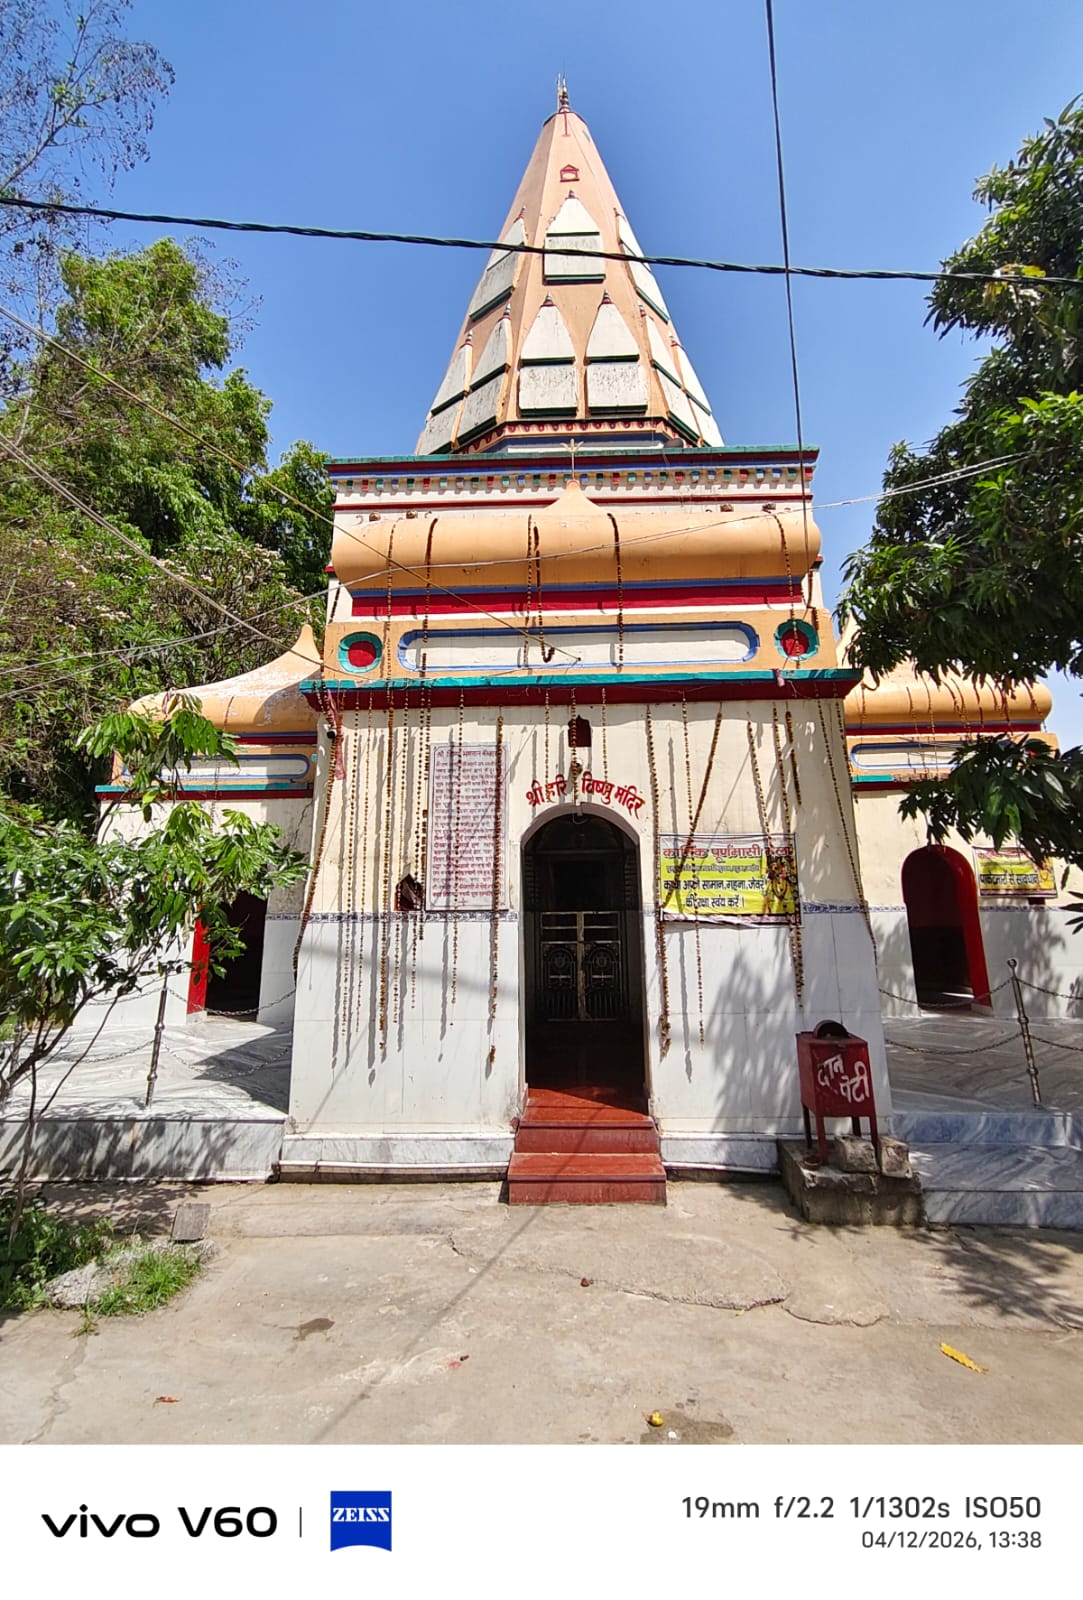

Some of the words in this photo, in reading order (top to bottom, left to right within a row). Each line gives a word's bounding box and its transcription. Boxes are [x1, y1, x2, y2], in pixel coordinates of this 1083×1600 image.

[526, 779, 545, 806] श्री
[545, 773, 568, 803] हरि
[581, 771, 614, 804] विष्णु
[614, 785, 645, 819] मंदिर
[663, 844, 708, 858] कार्िक
[817, 1054, 844, 1087] दान
[840, 1061, 870, 1103] पेटी
